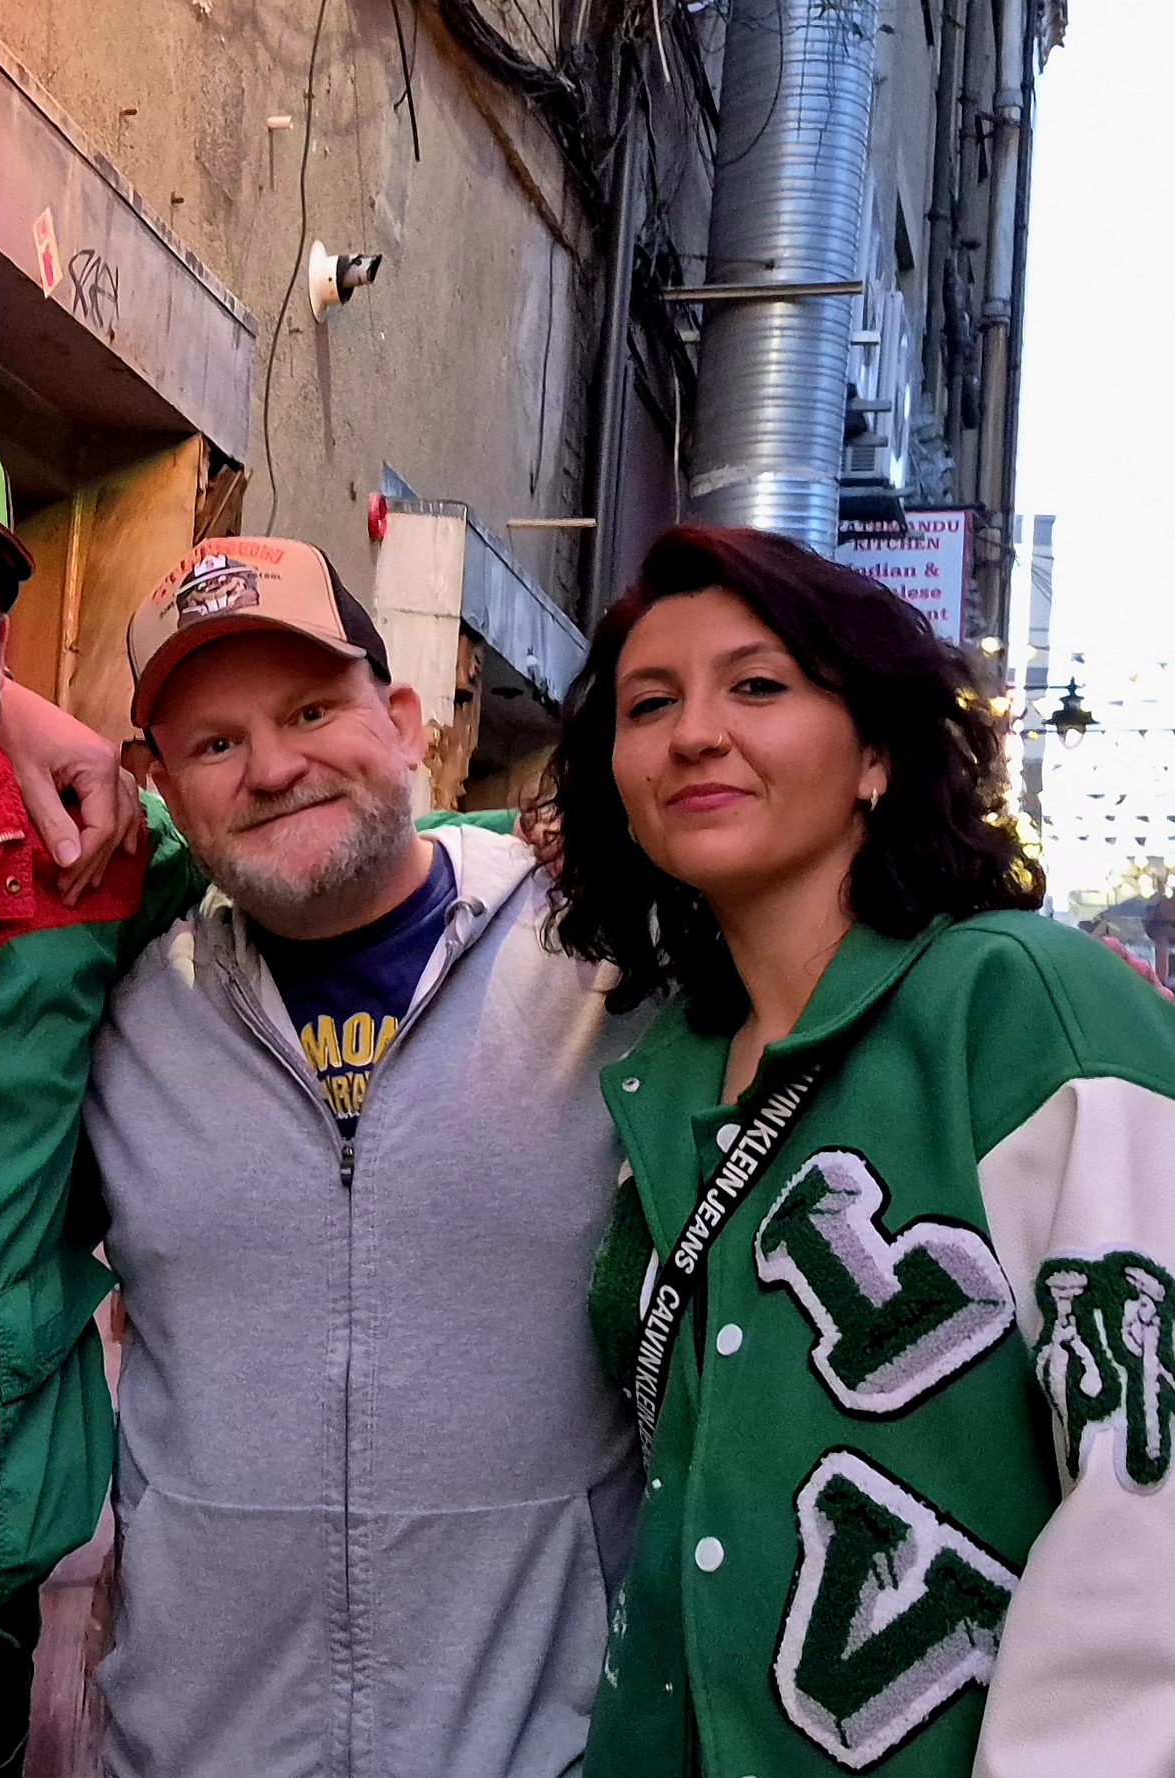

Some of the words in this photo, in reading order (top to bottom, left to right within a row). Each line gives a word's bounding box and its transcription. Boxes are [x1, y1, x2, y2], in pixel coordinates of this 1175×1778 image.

[853, 537, 940, 551] KITCHEN
[924, 562, 939, 578] &
[715, 1117, 779, 1198] KLEIN
[674, 1187, 727, 1275] JEANS
[637, 1284, 681, 1374] CALVIN
[635, 1365, 658, 1429] KLEIN
